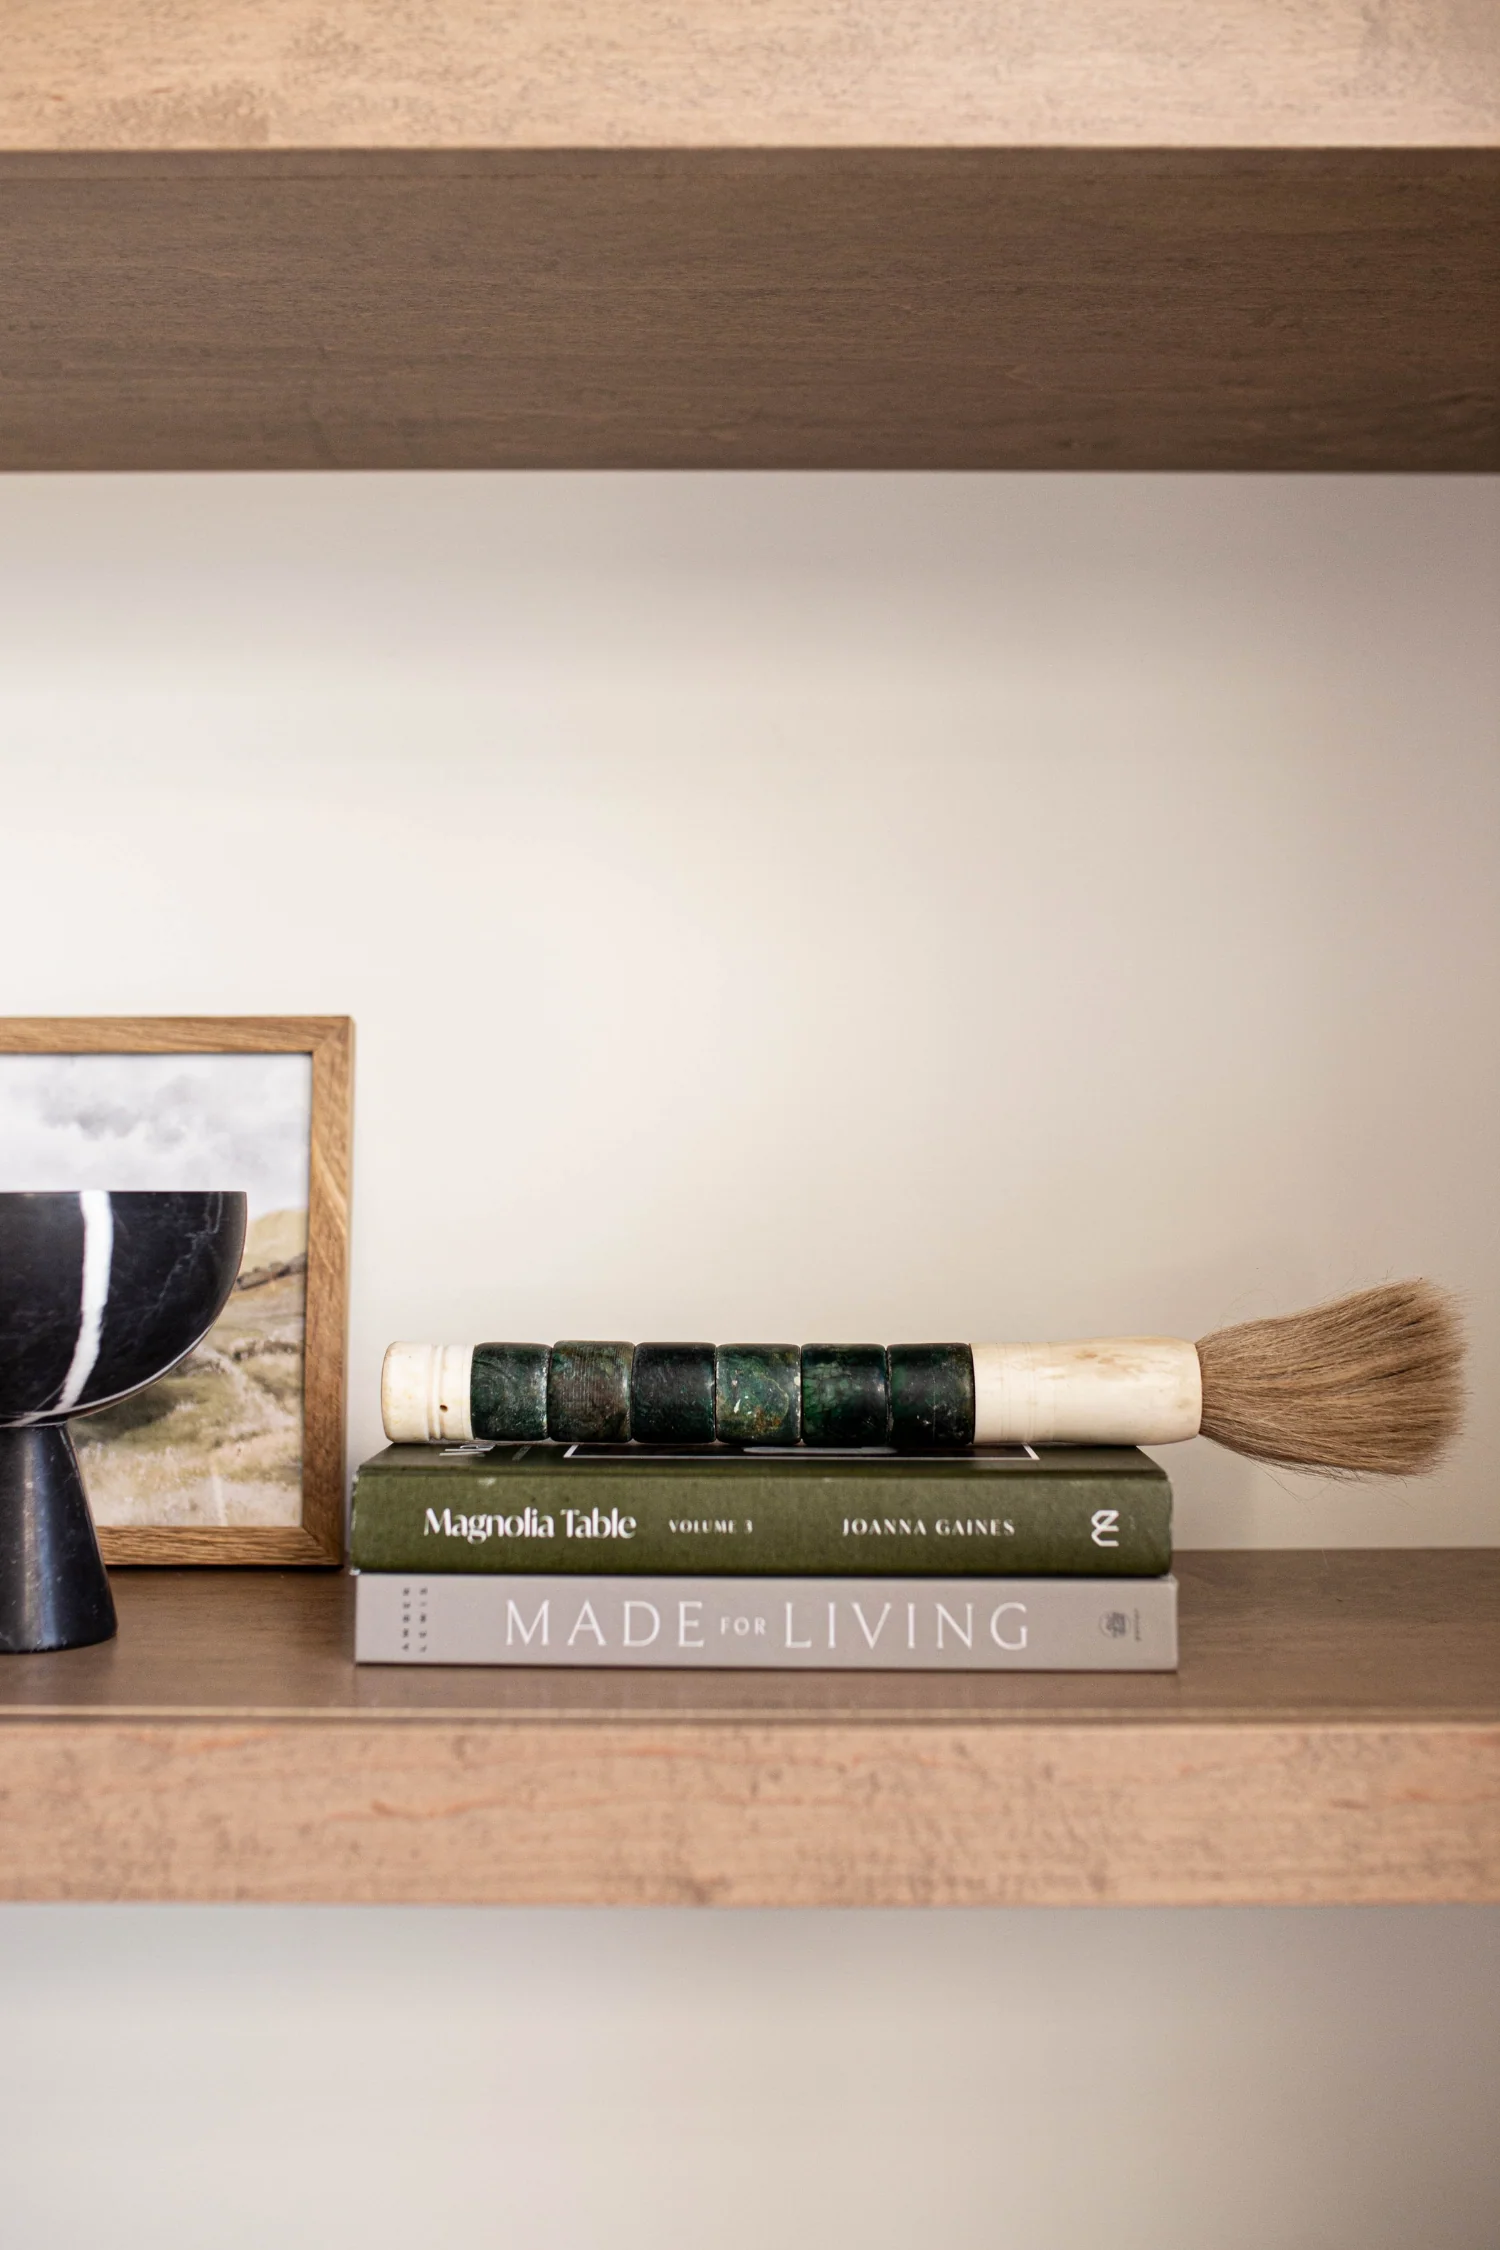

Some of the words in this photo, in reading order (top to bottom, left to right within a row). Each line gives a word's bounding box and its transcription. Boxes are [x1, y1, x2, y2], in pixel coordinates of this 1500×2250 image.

[424, 1507, 555, 1545] Magnolia
[560, 1507, 637, 1539] Table
[669, 1519, 737, 1534] VOLUME
[842, 1518, 927, 1536] JOANNA
[935, 1518, 1015, 1536] GAINES
[505, 1600, 704, 1648] MADE
[720, 1617, 766, 1636] FOR
[784, 1601, 1028, 1650] LIVING
